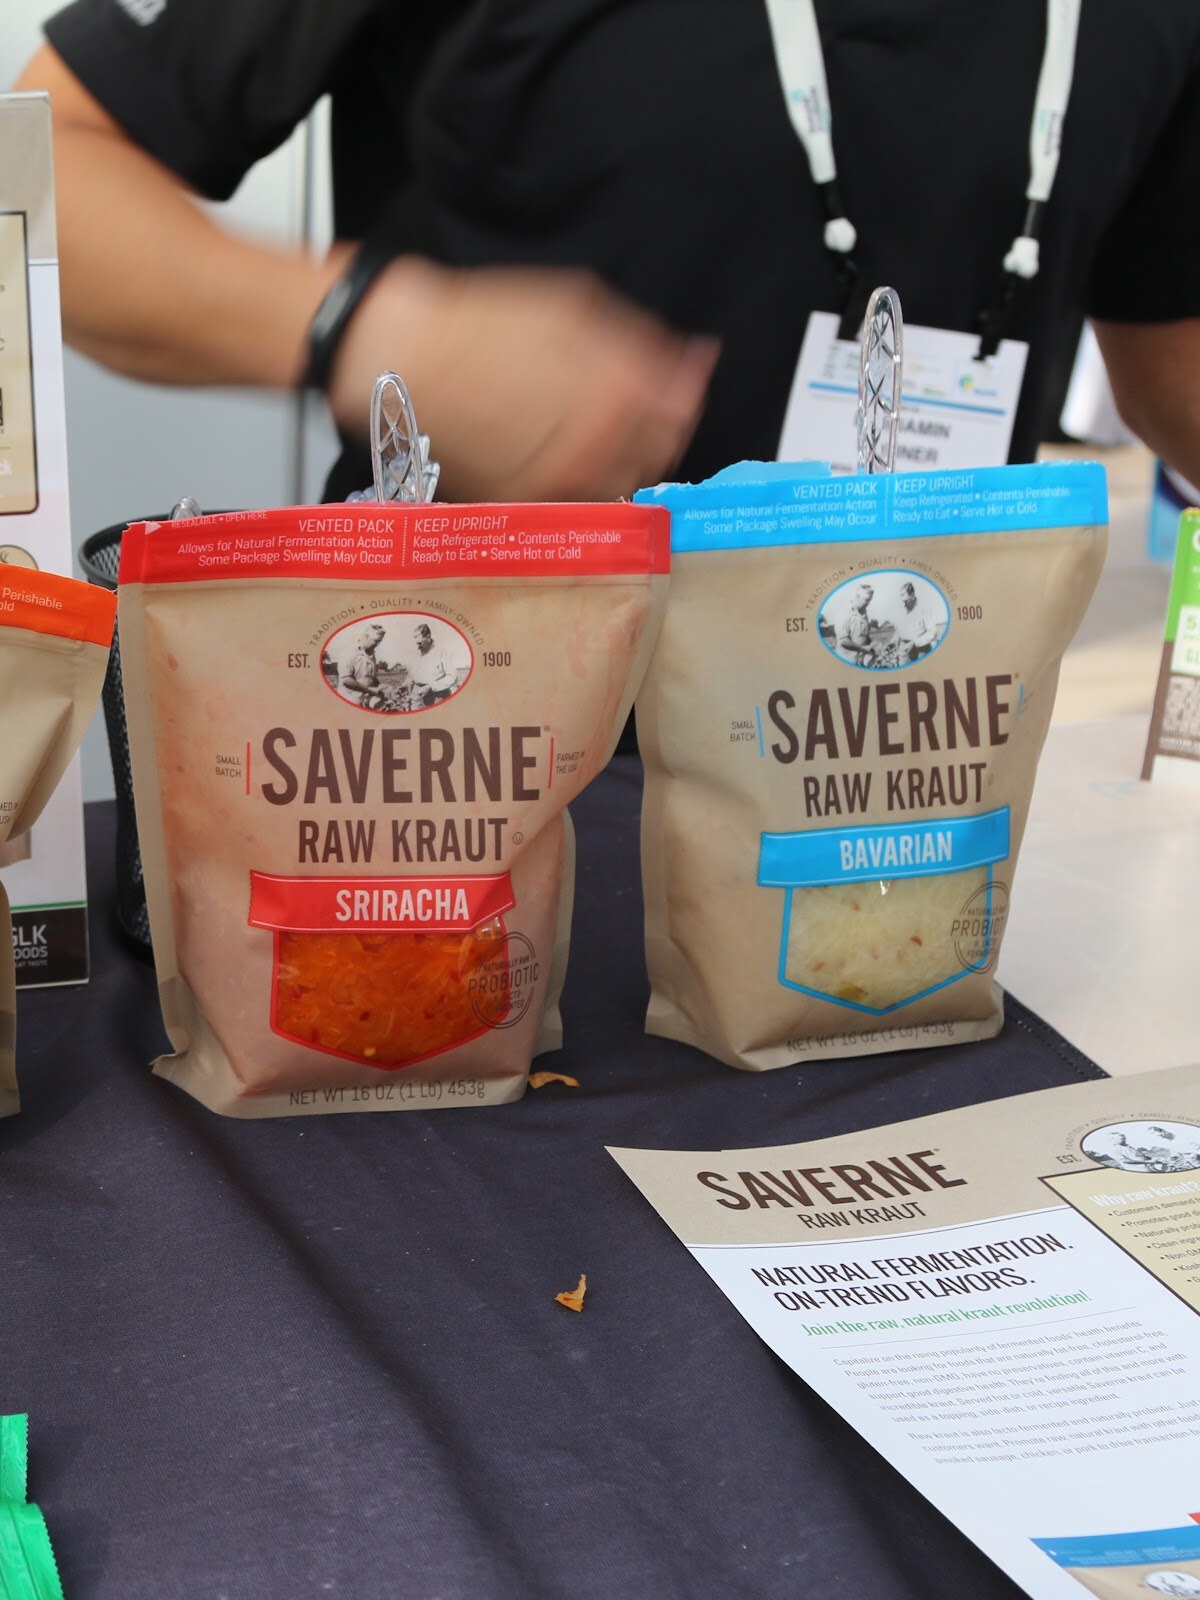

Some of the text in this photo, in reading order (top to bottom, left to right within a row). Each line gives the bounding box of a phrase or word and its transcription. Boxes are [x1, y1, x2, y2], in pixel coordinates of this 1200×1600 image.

[793, 481, 877, 499] VENTED PACK
[895, 475, 974, 493] KEEP UPRIGHT
[299, 519, 394, 533] VENTED PACK
[415, 516, 508, 532] KEEP UPRIGHT
[2, 587, 62, 610] Perishable
[786, 605, 982, 632] EST. 1900
[288, 651, 511, 668] EST. 1900
[731, 720, 754, 729] SMALL
[767, 674, 1012, 764] SAVERNE
[730, 732, 756, 742] BATCH
[261, 726, 542, 806] SAVERNE
[803, 762, 987, 818] RAW KRAUT
[299, 818, 507, 864] RAW KRAUT
[839, 831, 953, 871] BAVARIAN
[335, 888, 470, 921] SRIRACHA
[467, 962, 539, 995] PROBIOTIC
[1056, 1153, 1082, 1166] EST.
[695, 1149, 967, 1211] SAVERNE
[798, 1202, 928, 1231] RAW KRAUT
[751, 1232, 1074, 1287] NATURAL FERMENTATION.
[773, 1268, 1036, 1312] ON-TREND FLAVORS.
[802, 1290, 1092, 1337] Join the raw, natural kraut revolution!
